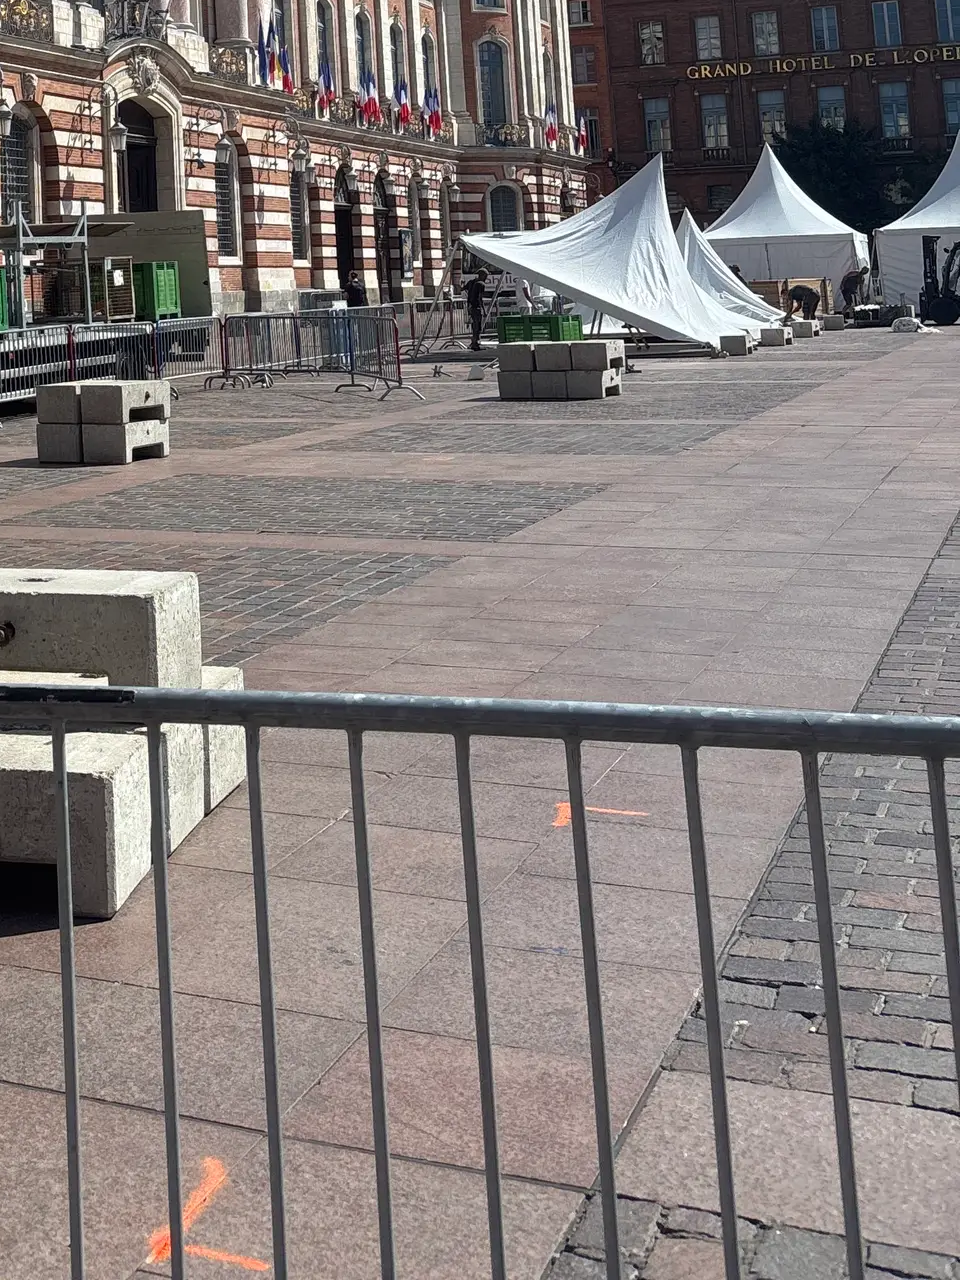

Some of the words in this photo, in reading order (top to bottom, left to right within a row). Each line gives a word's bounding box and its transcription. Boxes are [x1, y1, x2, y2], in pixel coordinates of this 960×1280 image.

[686, 62, 752, 79] GRAND
[768, 56, 836, 73] HOTEL
[849, 53, 877, 68] DE
